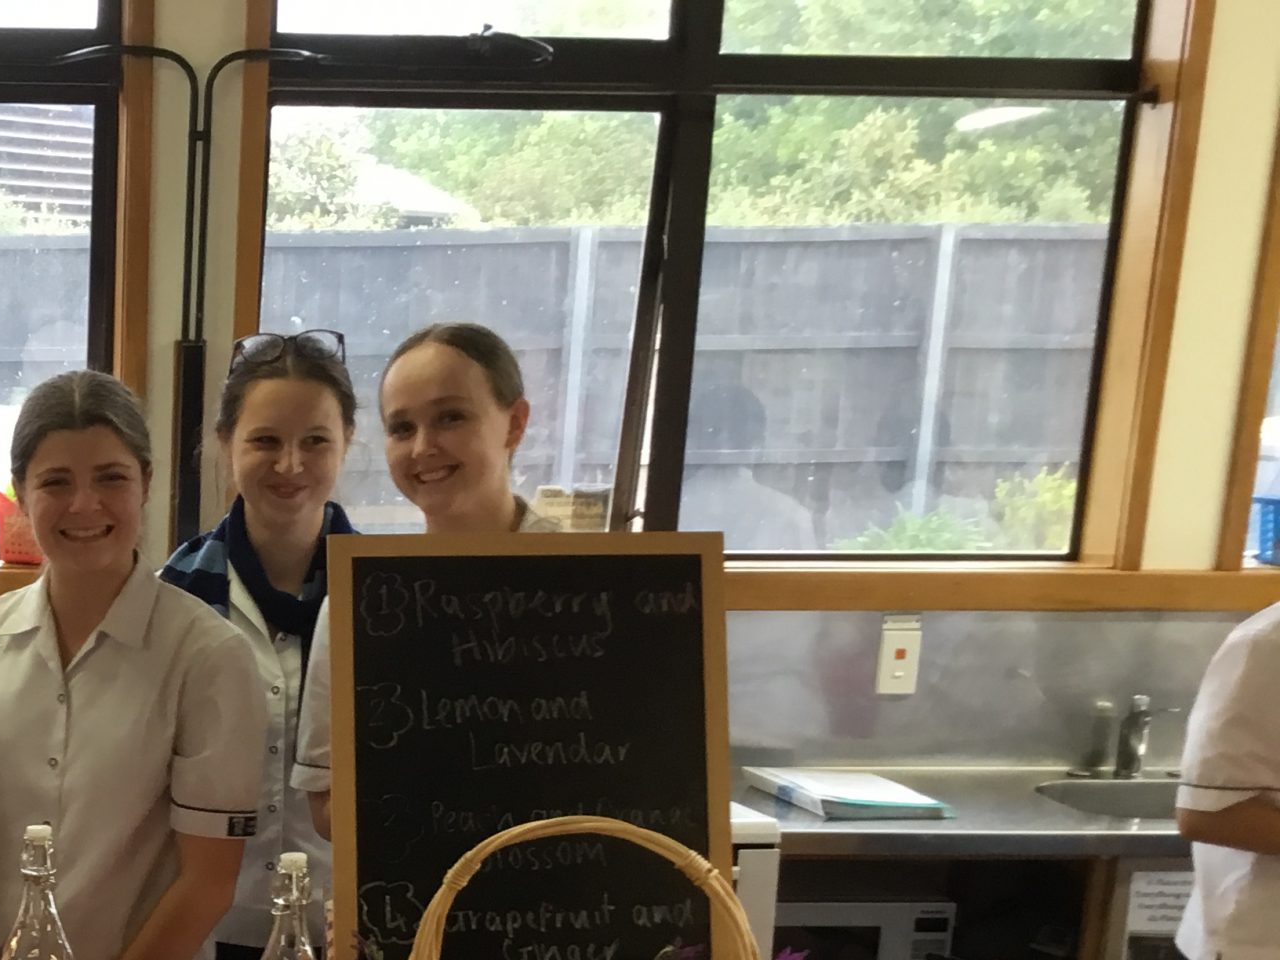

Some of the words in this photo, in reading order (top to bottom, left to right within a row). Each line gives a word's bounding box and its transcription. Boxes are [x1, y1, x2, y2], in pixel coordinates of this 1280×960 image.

[412, 578, 613, 638] Raspberry
[633, 581, 699, 614] and
[450, 630, 607, 667] Hibiscus
[420, 689, 520, 730] Lemon
[531, 690, 593, 721] and
[470, 731, 631, 771] Lavendar
[482, 840, 608, 873] lossom
[447, 892, 616, 939] Grapefruit
[632, 898, 694, 929] and
